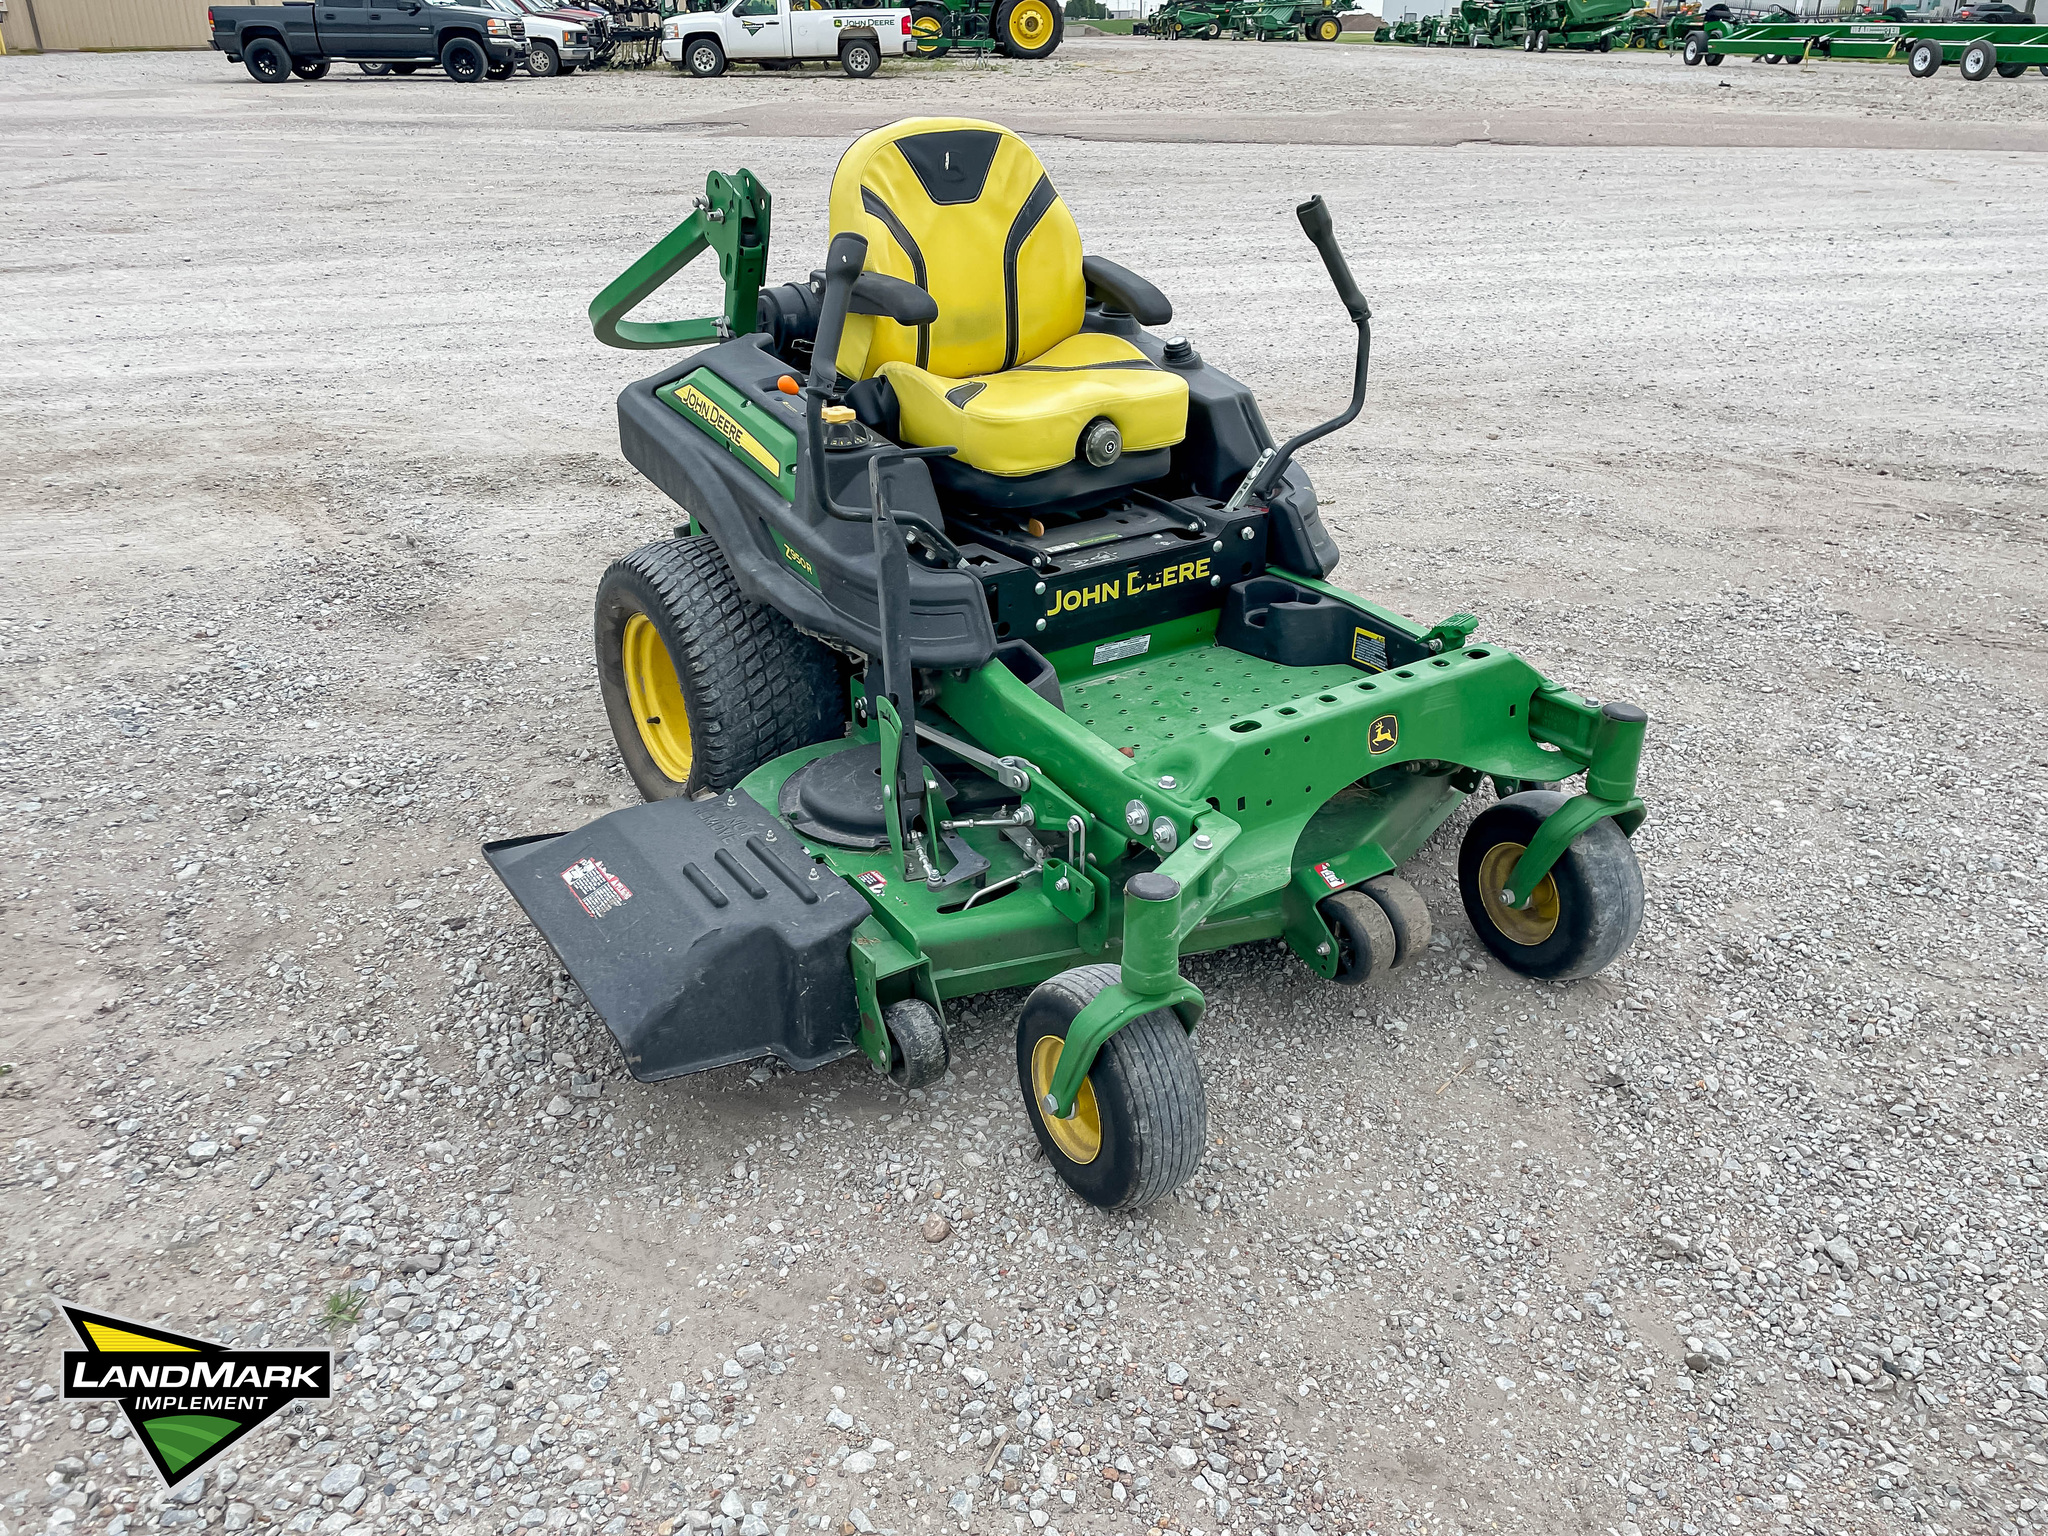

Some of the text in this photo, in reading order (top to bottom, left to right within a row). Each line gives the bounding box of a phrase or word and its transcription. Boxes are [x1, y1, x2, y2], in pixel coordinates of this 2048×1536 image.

[844, 18, 895, 27] JOHN DEERE
[683, 388, 743, 445] JOHN DEERE
[783, 543, 813, 575] Z950R
[1046, 579, 1120, 617] JOHN
